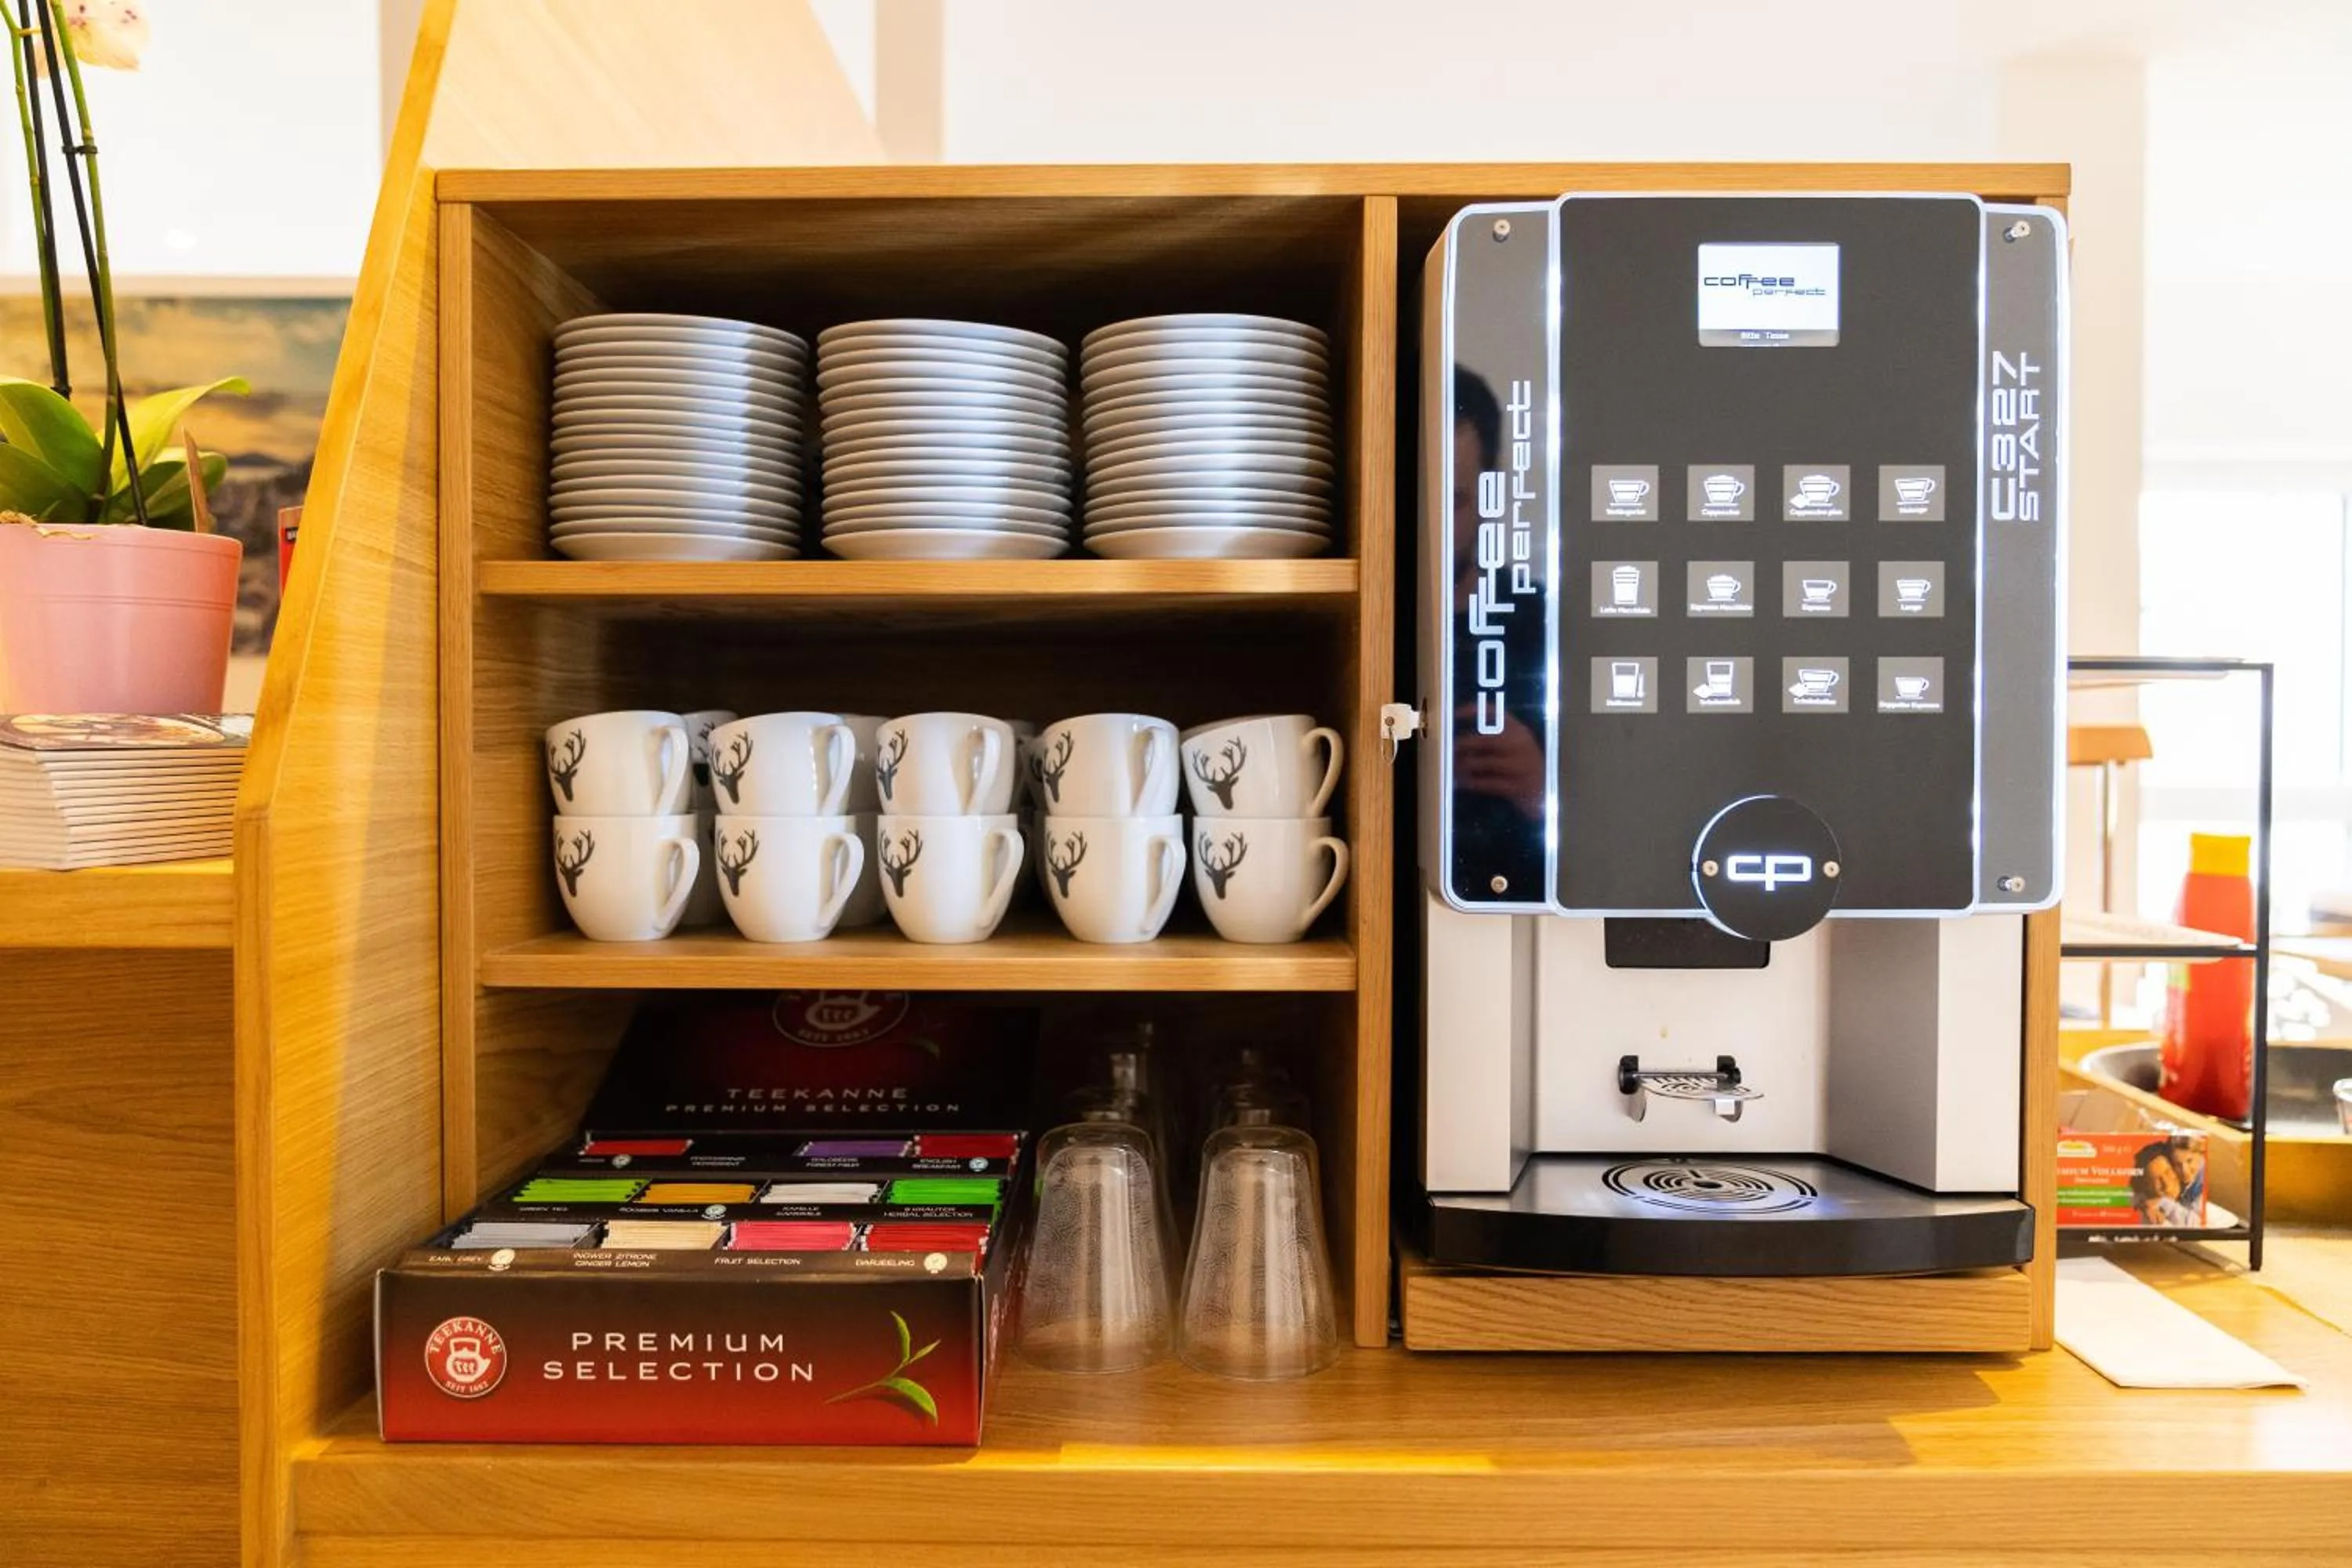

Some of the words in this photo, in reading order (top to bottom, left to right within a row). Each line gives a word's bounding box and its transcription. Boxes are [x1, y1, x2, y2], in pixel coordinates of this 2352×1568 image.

[1704, 274, 1795, 289] coffee
[1752, 287, 1827, 296] perfect
[1991, 350, 2018, 521] C327
[2019, 352, 2041, 521] START
[1507, 380, 1537, 593] perfect
[1468, 471, 1515, 735] coffee
[1727, 855, 1812, 891] cp
[727, 1088, 909, 1099] TEEKANNE
[429, 1320, 504, 1355] TEEKANNE
[572, 1332, 785, 1352] PREMIUM
[543, 1362, 813, 1381] SELECTION
